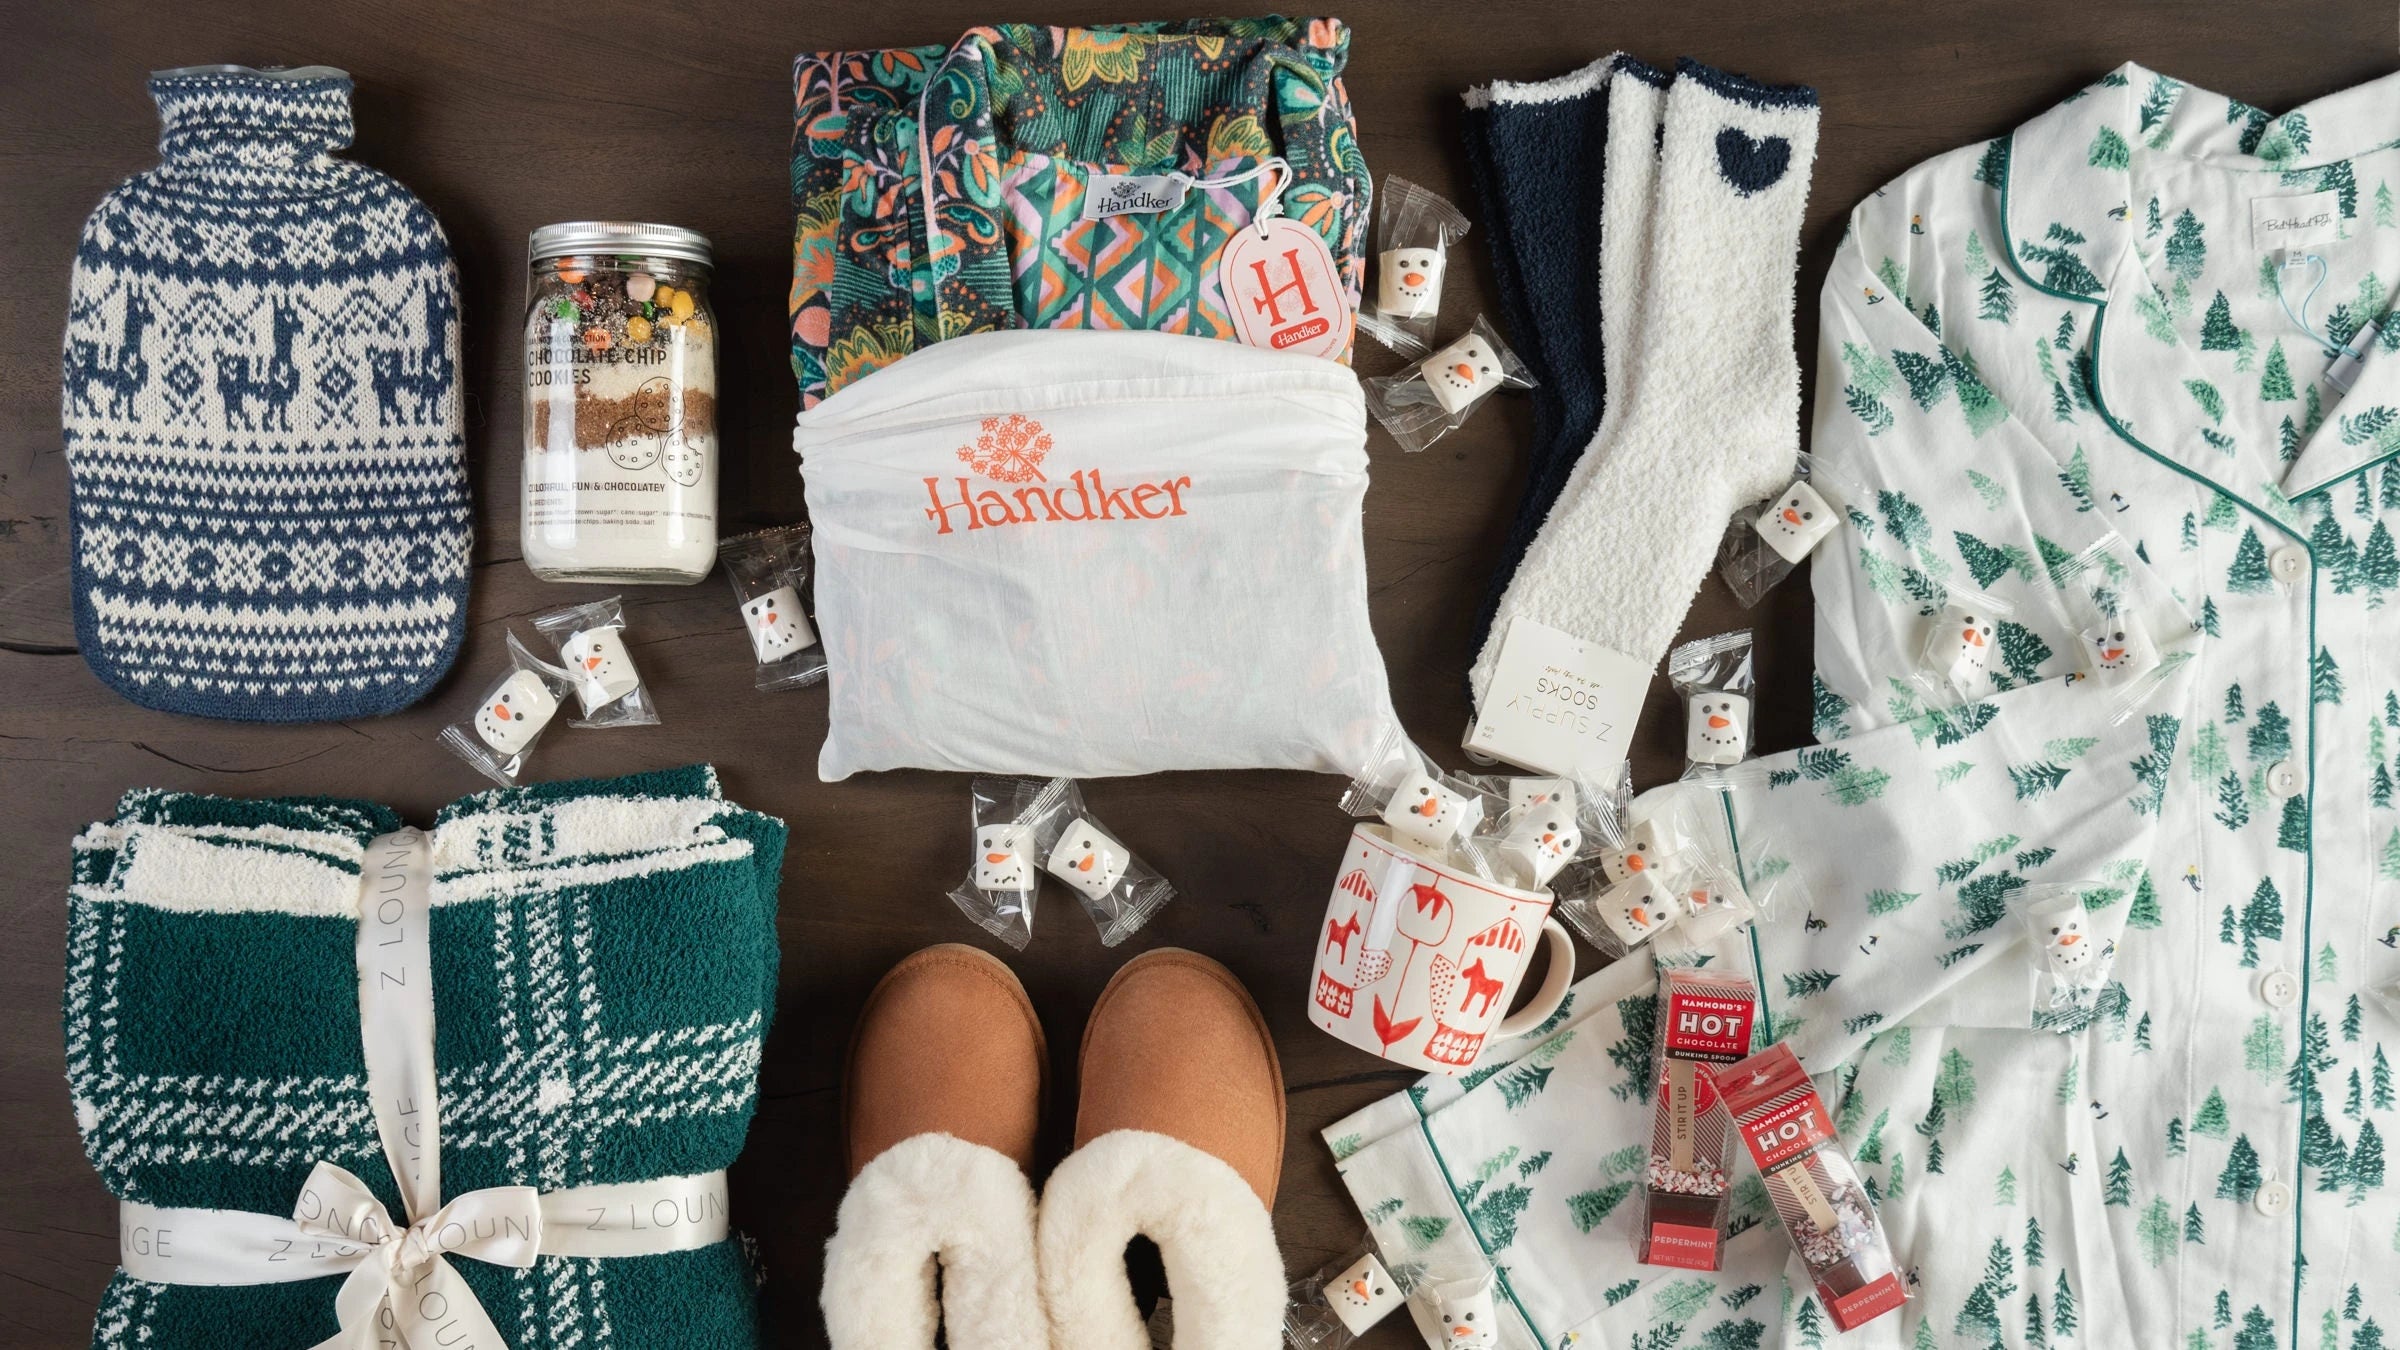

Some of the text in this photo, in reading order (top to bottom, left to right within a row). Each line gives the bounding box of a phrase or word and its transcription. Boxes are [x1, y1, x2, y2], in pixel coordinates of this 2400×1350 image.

[1097, 191, 1174, 213] Handker
[1249, 248, 1320, 328] H
[1278, 323, 1322, 346] Handker
[528, 347, 667, 367] CHOCOLATE CHIP
[528, 368, 591, 388] COOKIES
[571, 481, 590, 491] FUN
[593, 481, 600, 491] &
[604, 481, 665, 492] CHOCOLATEY
[922, 468, 1191, 534] Handker
[1536, 677, 1599, 710] SOCKS
[1506, 692, 1613, 742] Z SUPPLY
[380, 966, 406, 991] Z
[1679, 1011, 1743, 1038] HOT
[1676, 1037, 1739, 1050] CHOCOLATE
[1674, 1050, 1737, 1062] DUNKING SPOON
[1677, 1086, 1687, 1140] STIR IT UP
[1757, 1109, 1816, 1153] HOT
[1765, 1130, 1826, 1163] CHOCOLATE
[1770, 1153, 1802, 1172] DUNKING
[1803, 1141, 1829, 1157] SPOON
[1791, 1175, 1803, 1190] IT
[1800, 1185, 1818, 1206] STIR
[586, 1207, 607, 1231] Z
[268, 1238, 293, 1262] Z
[1654, 1235, 1714, 1249] PEPPERMINT
[1841, 1282, 1896, 1315] PEPPERMINT
